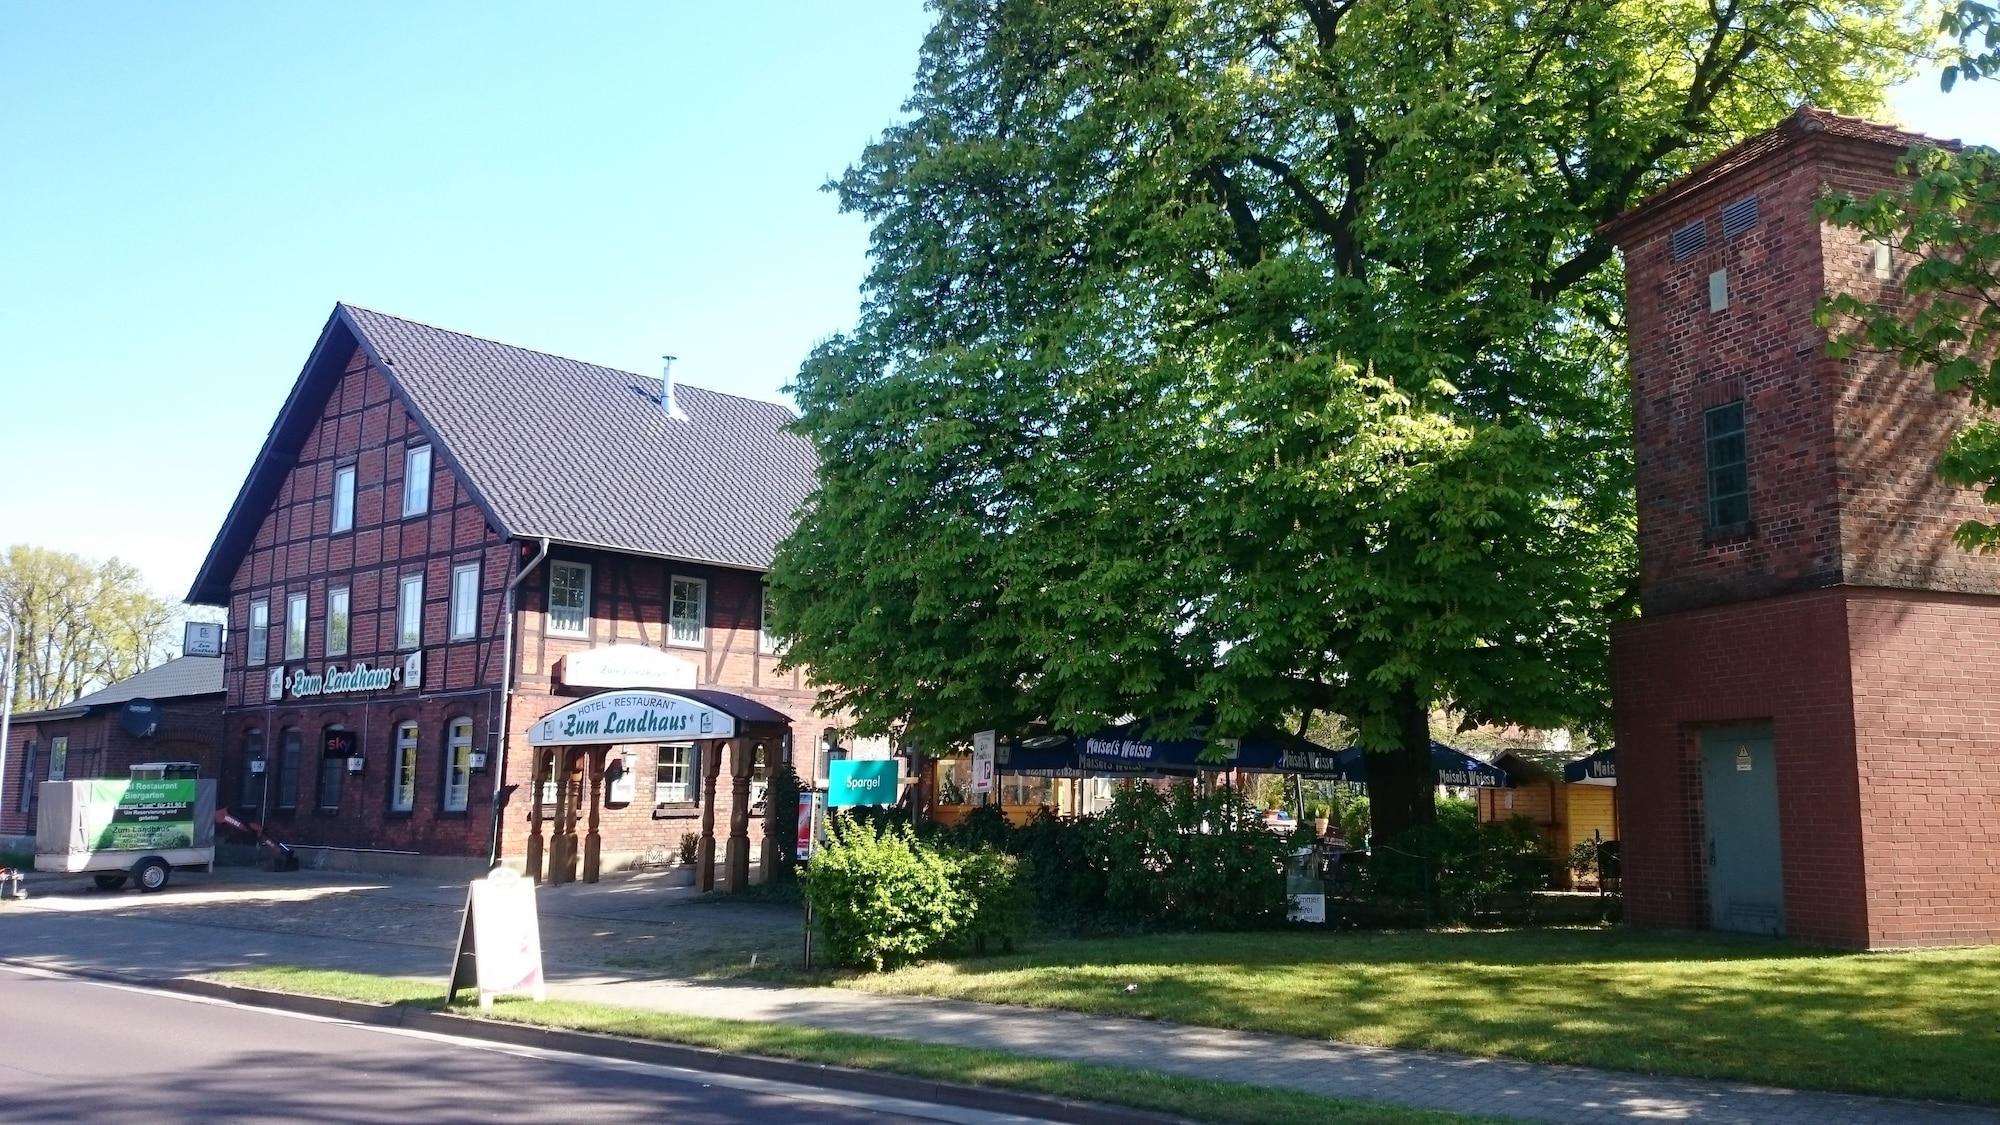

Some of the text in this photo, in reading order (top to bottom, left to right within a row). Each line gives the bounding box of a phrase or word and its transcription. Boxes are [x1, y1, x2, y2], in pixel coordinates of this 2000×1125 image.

[292, 663, 392, 698] Zum Landhaus
[577, 697, 677, 716] HOTEL RESTAURANT
[563, 709, 687, 737] Zum Landhaus
[327, 737, 352, 752] sky
[1086, 738, 1120, 756] Maisel's
[1121, 739, 1153, 758] Weisse
[1438, 769, 1496, 786] Maisel's Weisse
[1593, 760, 1616, 778] Mais
[846, 775, 881, 790] Spargel
[125, 792, 165, 800] Biergarten
